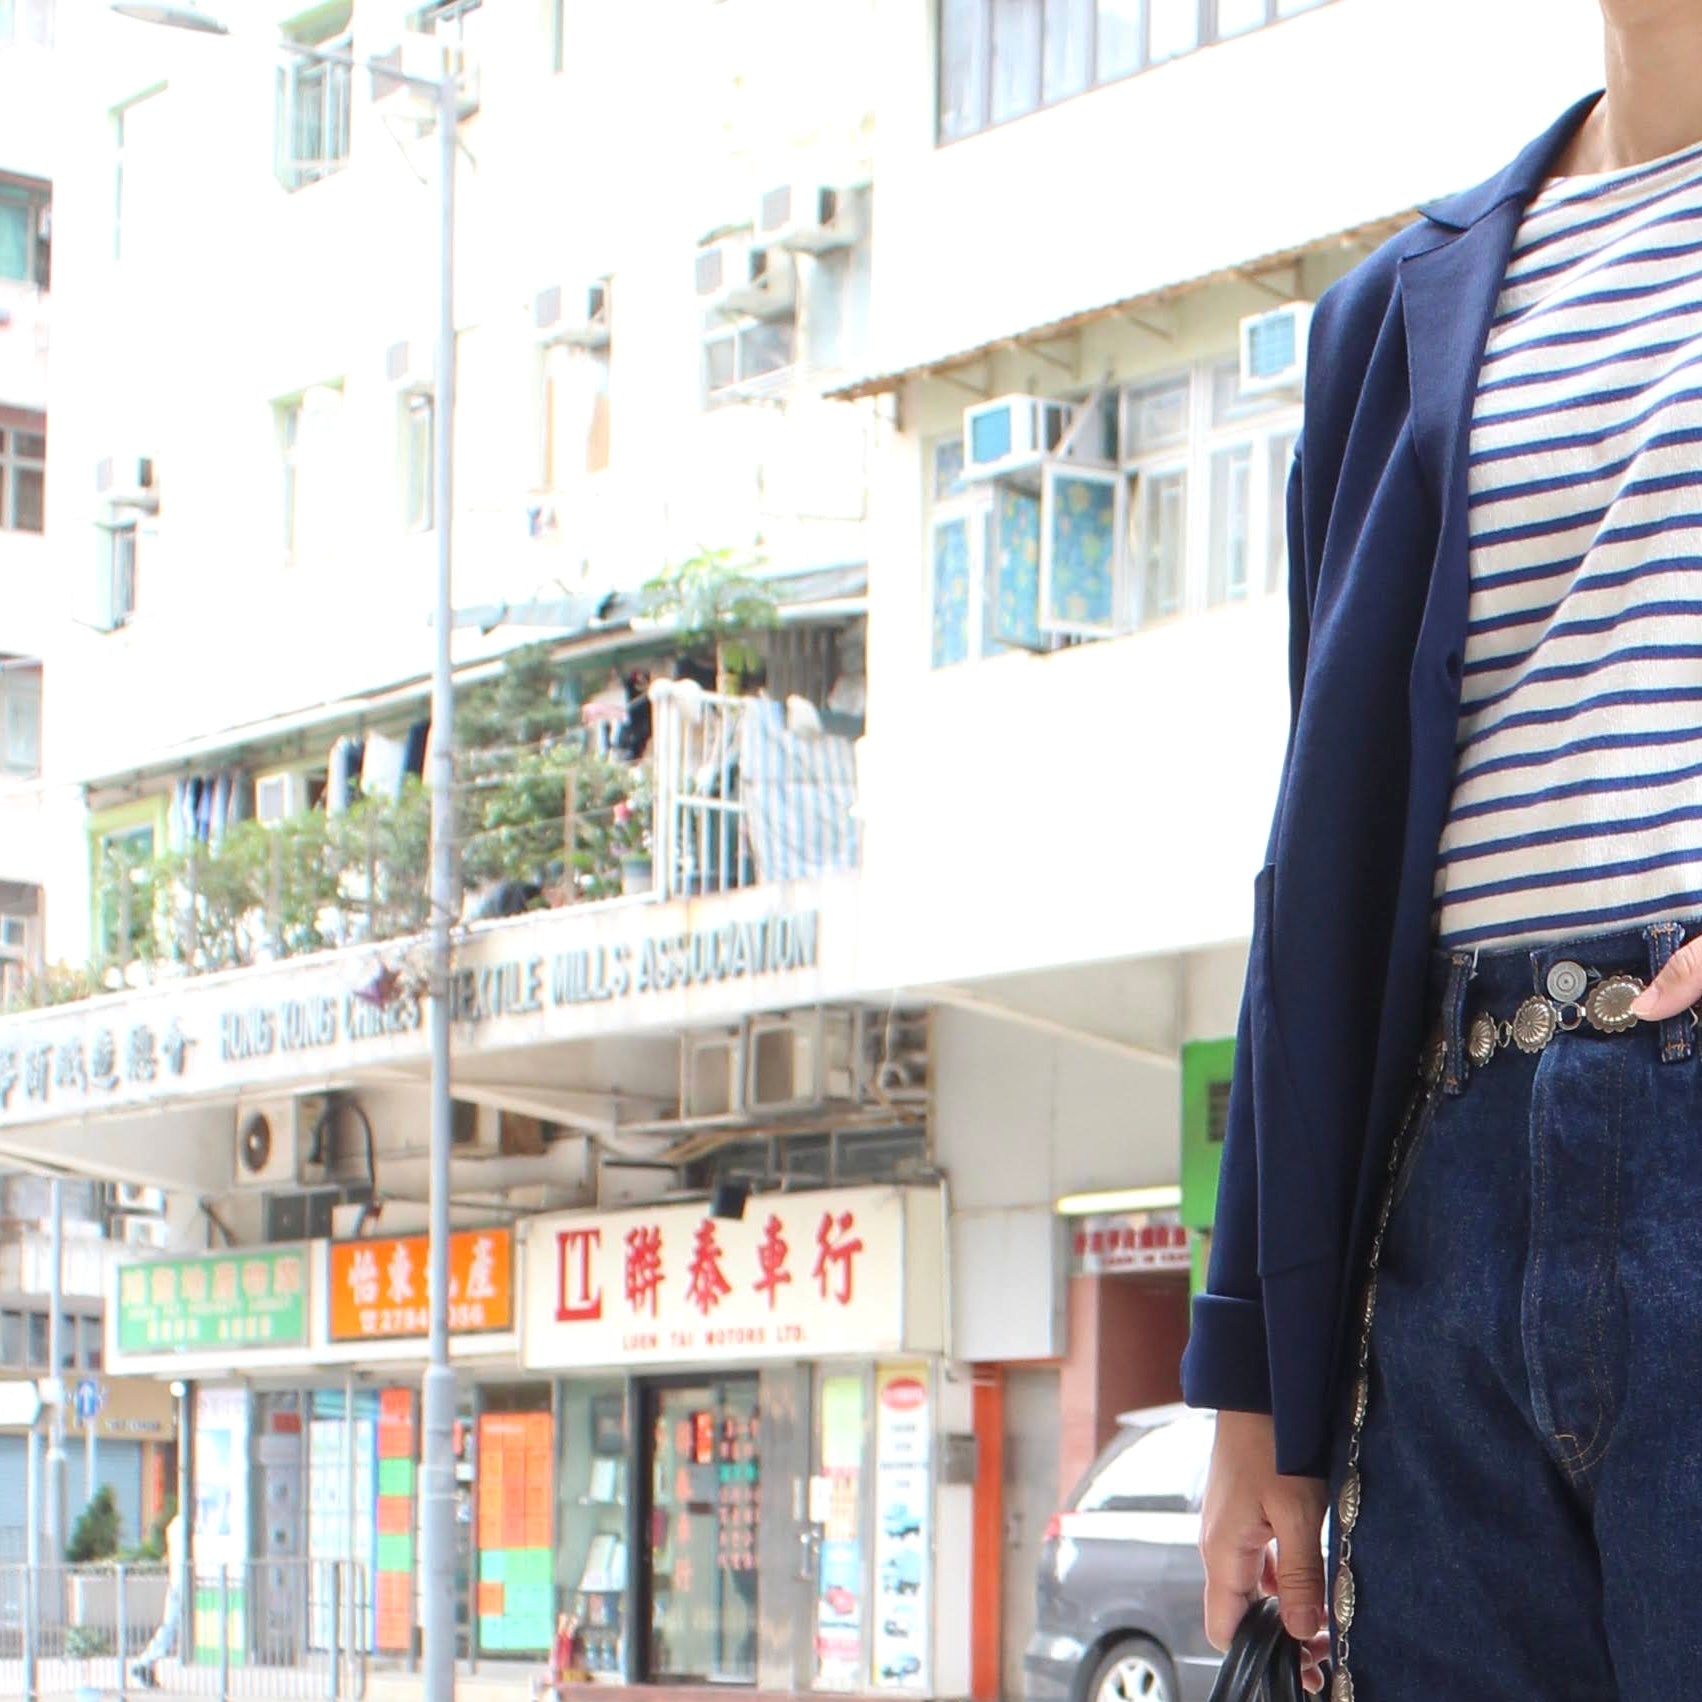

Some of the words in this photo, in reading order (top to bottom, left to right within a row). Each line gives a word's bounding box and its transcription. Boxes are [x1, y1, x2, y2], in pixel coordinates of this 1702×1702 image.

[221, 1008, 275, 1061] HONG
[277, 995, 337, 1050] KONG
[551, 943, 632, 1007] MILLS
[624, 1211, 863, 1319] 聯泰車行
